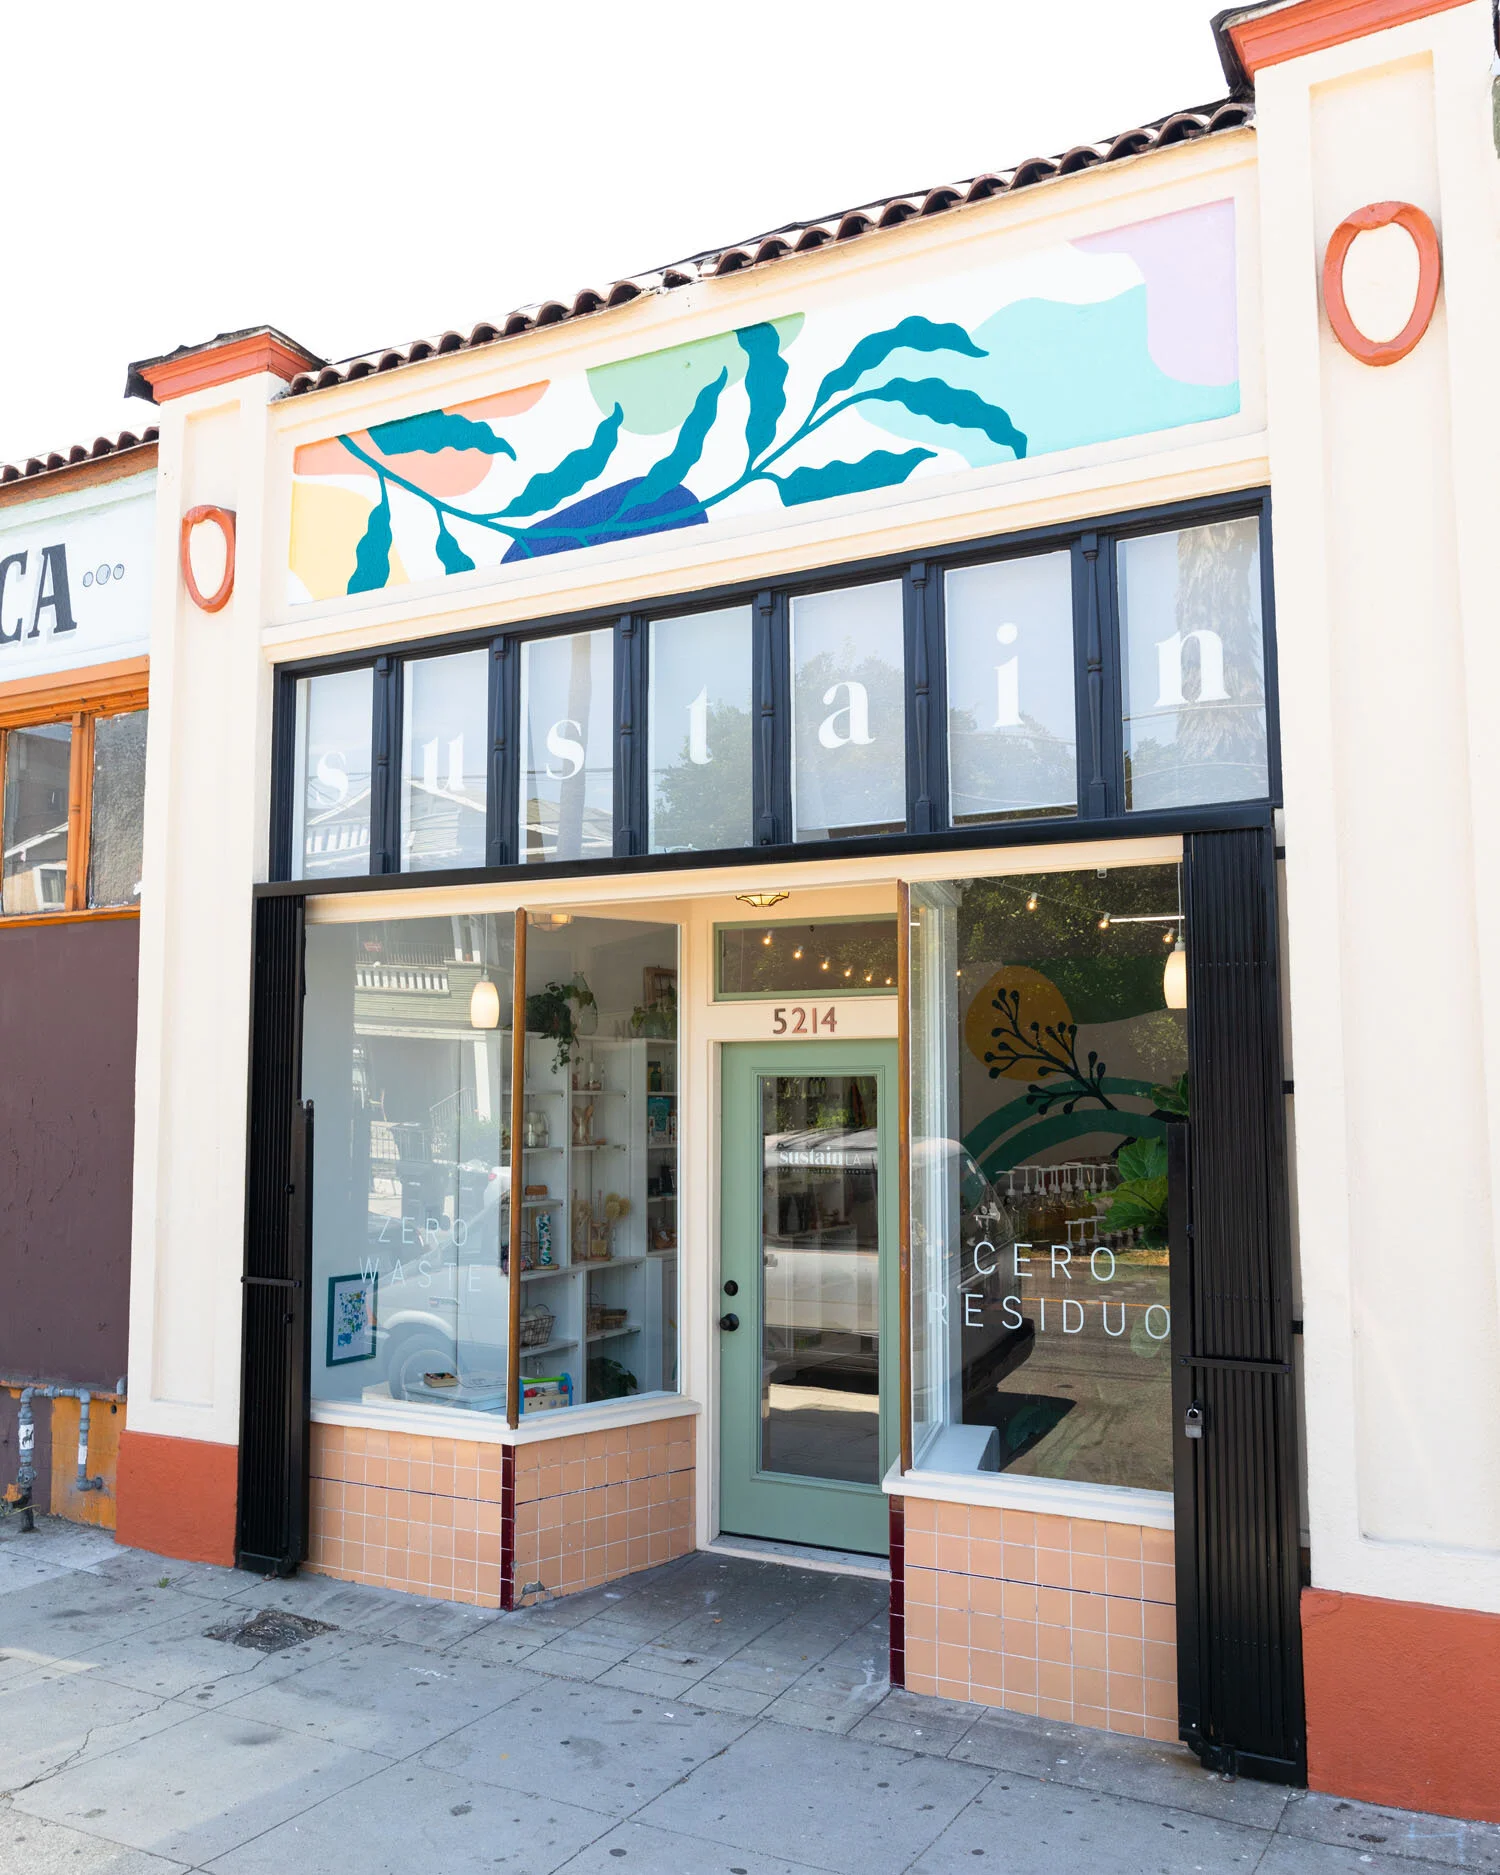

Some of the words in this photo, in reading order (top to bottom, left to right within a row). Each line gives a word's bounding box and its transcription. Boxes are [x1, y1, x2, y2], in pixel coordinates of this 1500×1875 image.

[316, 622, 1231, 805] sustain
[772, 1006, 838, 1035] 5214
[779, 1146, 843, 1166] sustain
[845, 1153, 861, 1166] LA
[378, 1216, 468, 1247] ZERO
[359, 1256, 483, 1292] WASTE
[973, 1241, 1116, 1282] CERO
[928, 1291, 1171, 1340] RESIDUO
